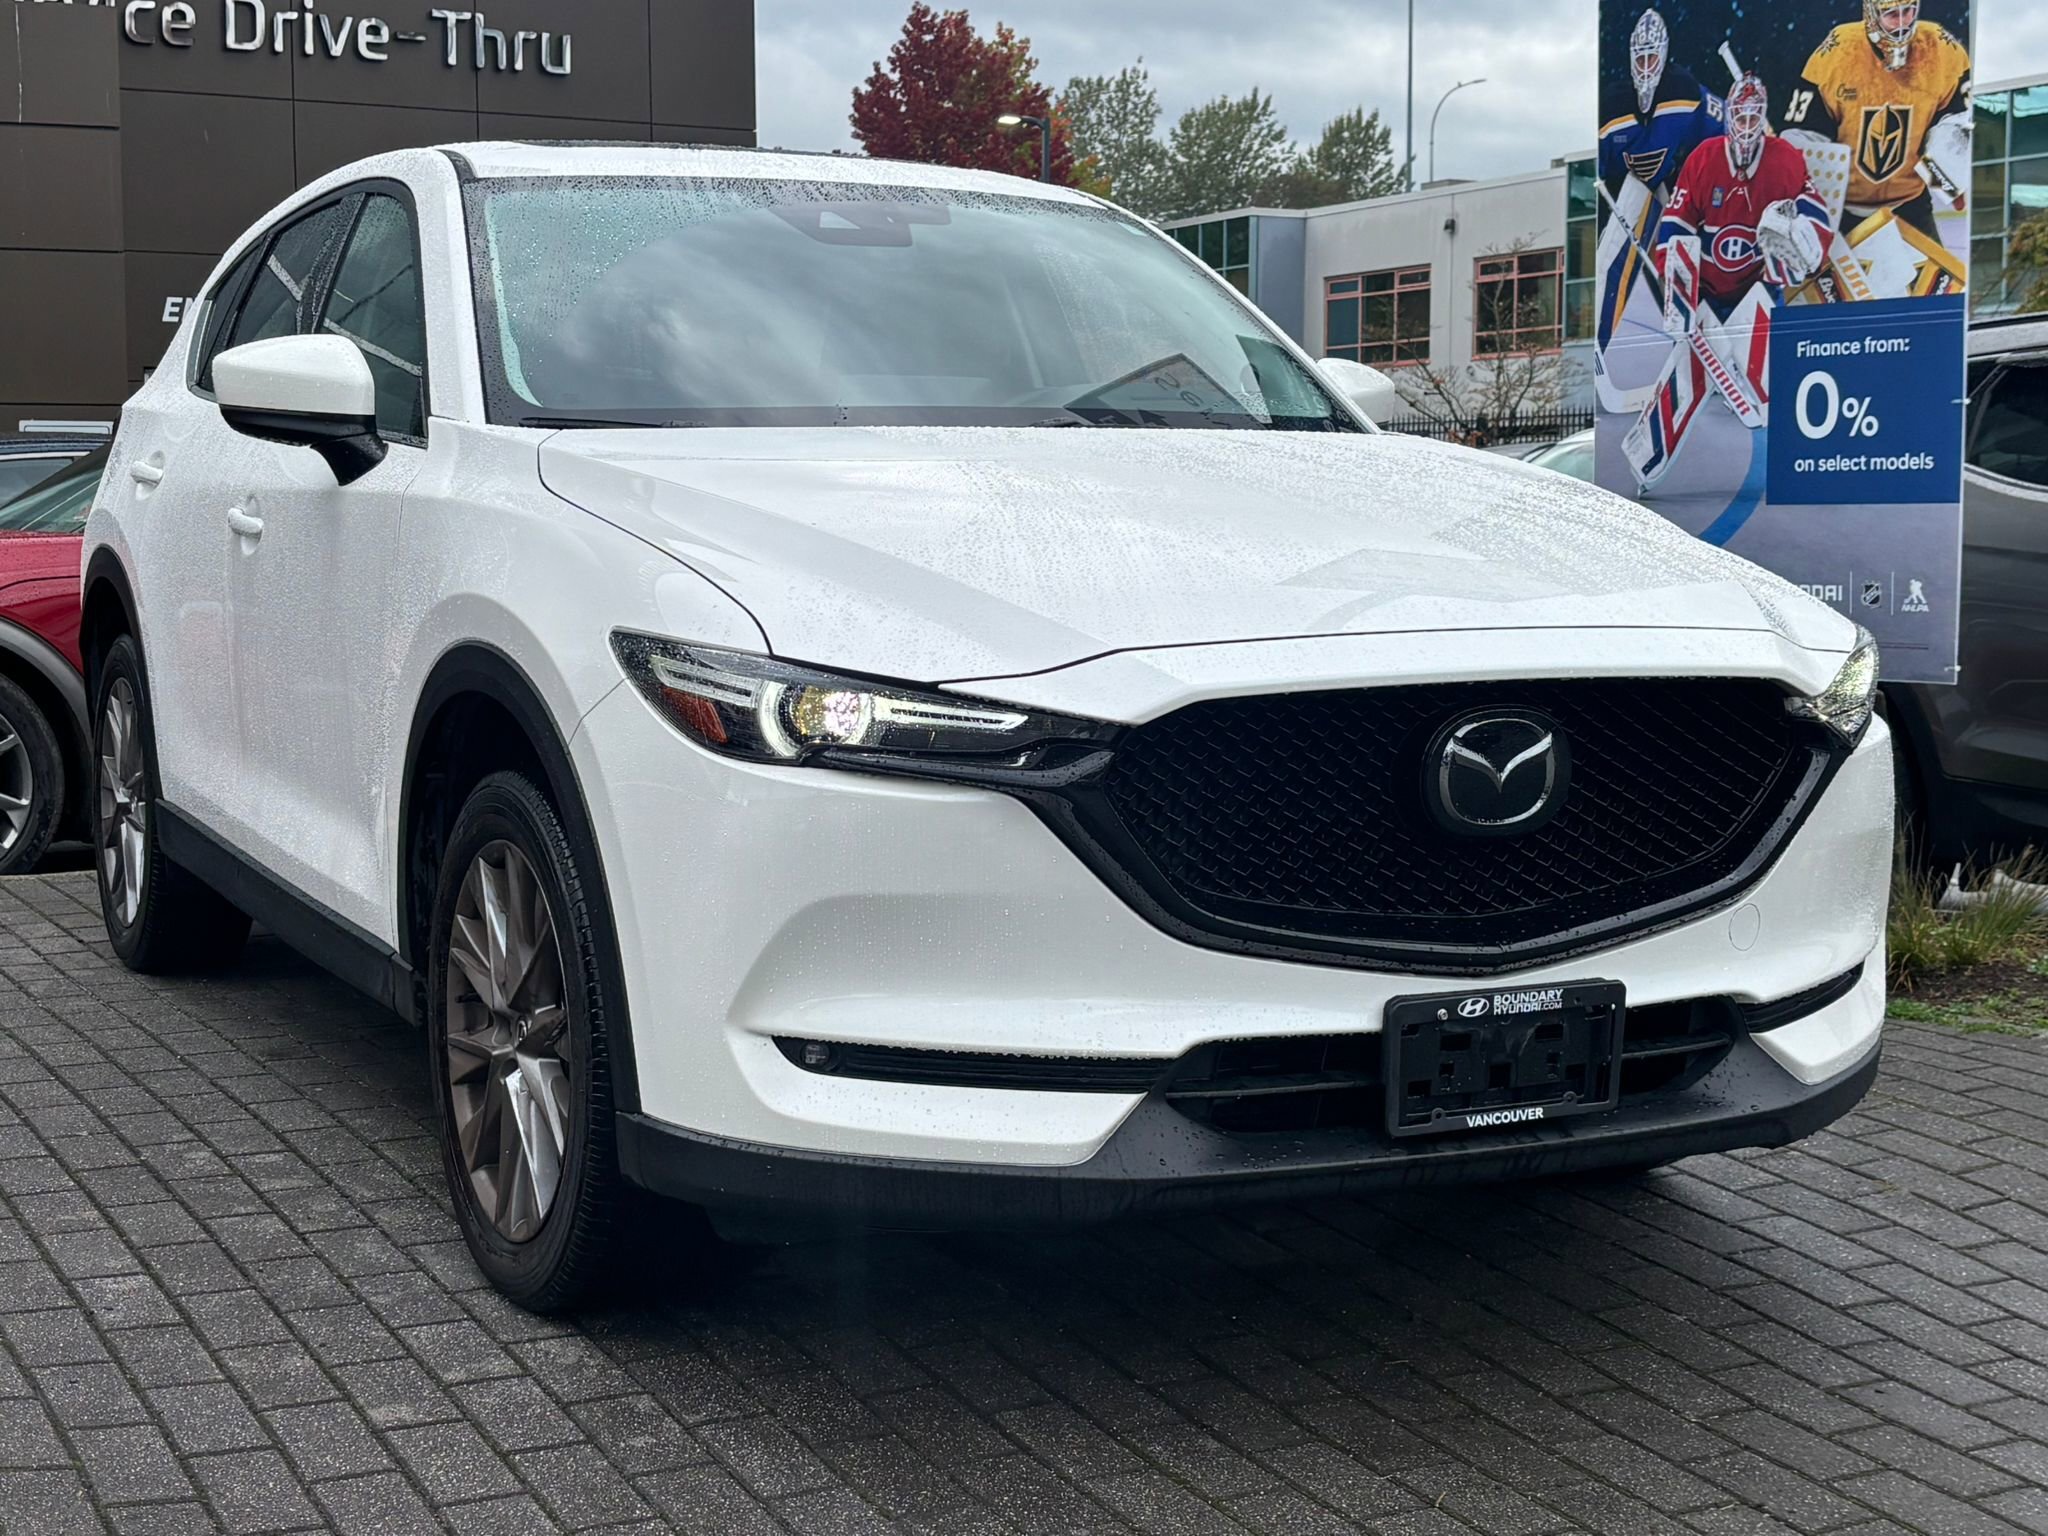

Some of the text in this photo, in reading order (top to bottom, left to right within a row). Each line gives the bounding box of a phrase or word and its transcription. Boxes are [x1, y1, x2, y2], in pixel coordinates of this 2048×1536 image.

[225, 0, 571, 75] Drive-Thru
[1797, 336, 1911, 358] Finance from:
[1796, 370, 1879, 439] 0%
[1794, 452, 1935, 472] on select models
[1493, 988, 1564, 1006] BOUNDARY
[1466, 1107, 1544, 1128] VANCOUVER
